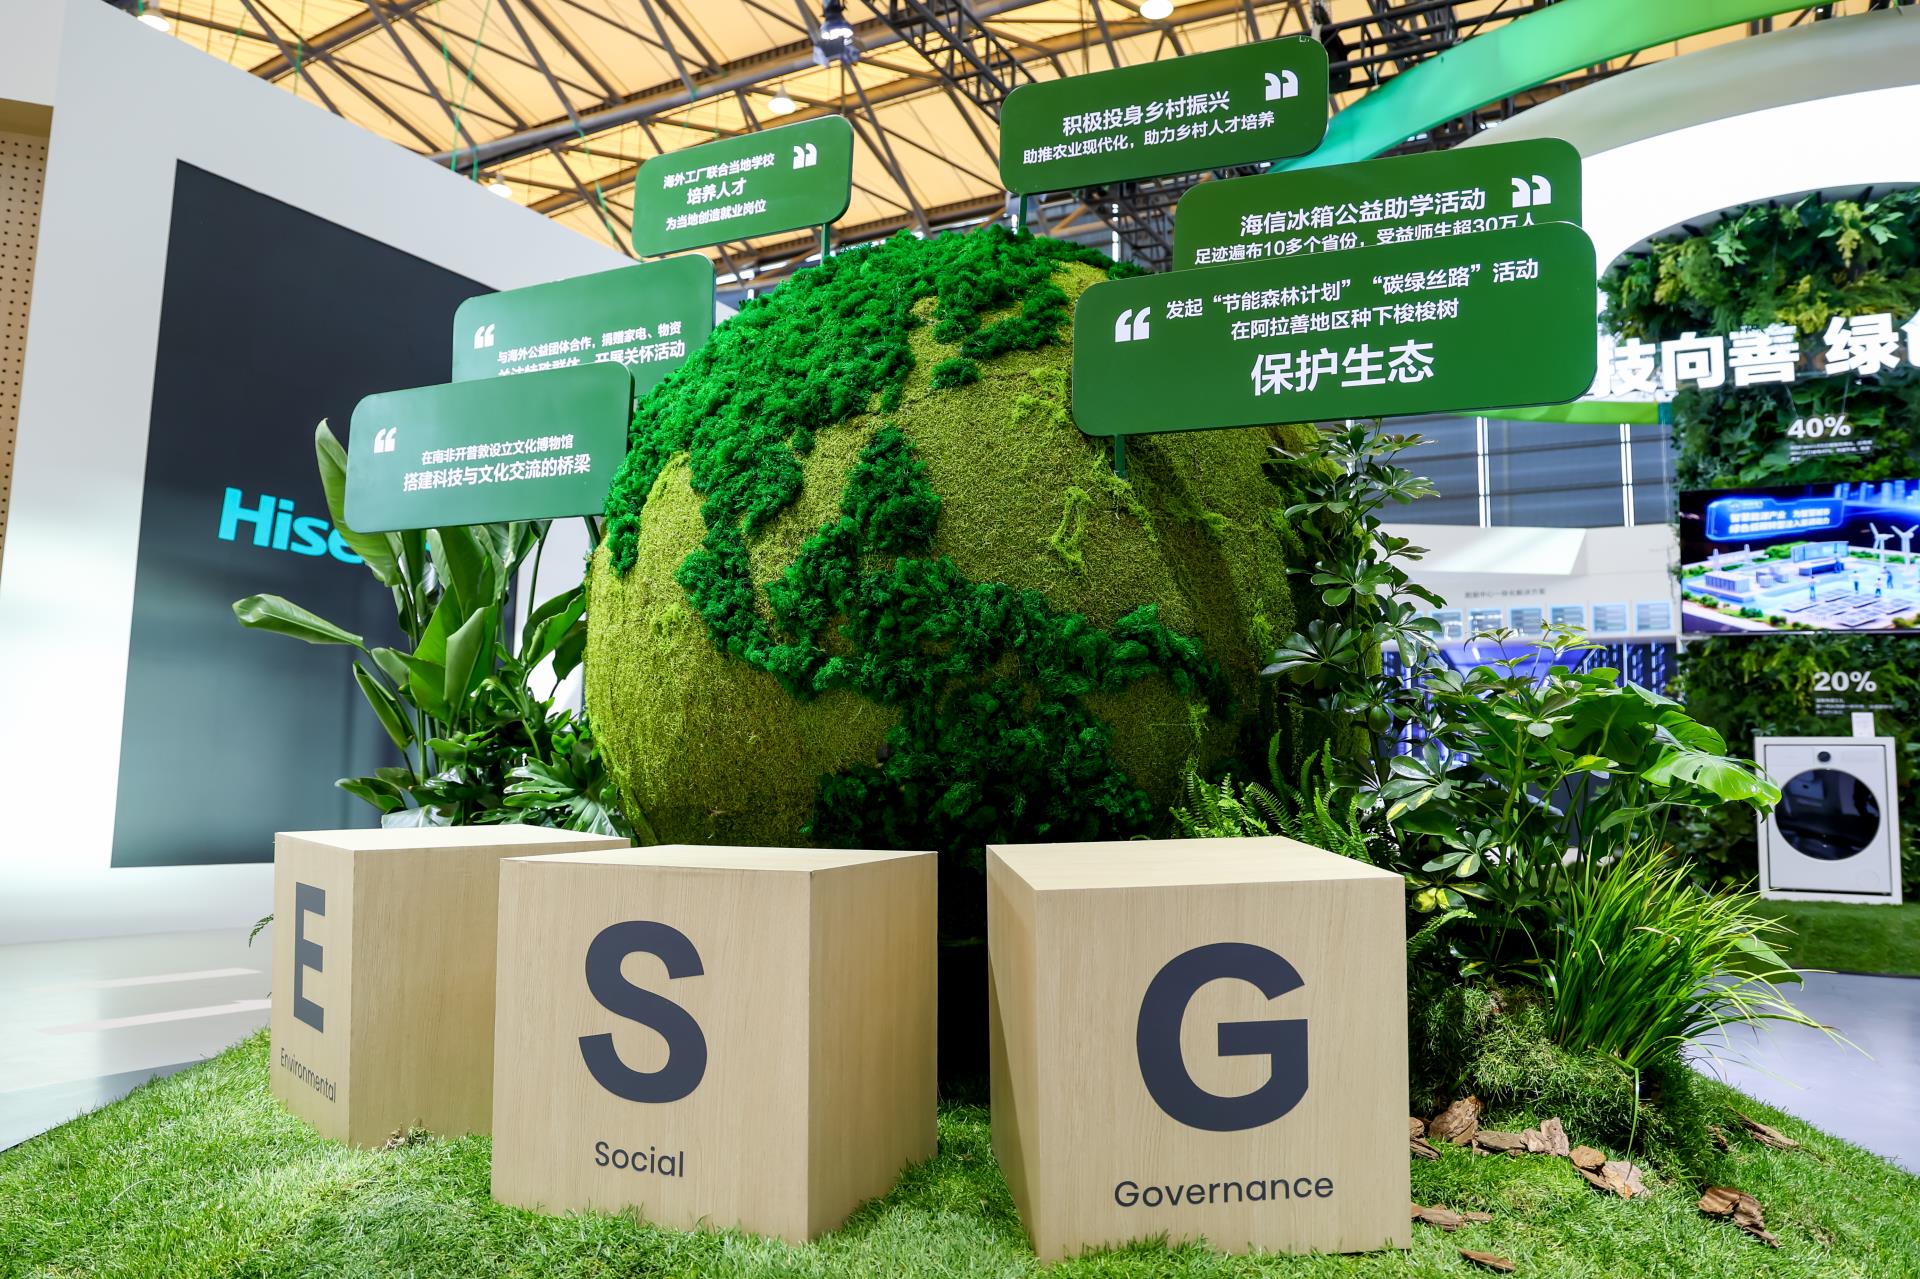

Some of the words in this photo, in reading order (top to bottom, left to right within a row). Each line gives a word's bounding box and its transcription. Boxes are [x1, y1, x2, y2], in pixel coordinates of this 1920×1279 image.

[1062, 90, 1230, 137] 积极投身乡村振兴
[1022, 110, 1275, 165] 助推农业现代化，助力乡村人才培养
[663, 152, 776, 189] 海外工厂联合当地学校
[686, 177, 747, 206] 培养人才
[1240, 187, 1486, 237] 海信冰箱公益助学活动
[665, 198, 767, 232] 为当地创造就业岗位
[1230, 297, 1460, 341] 在阿拉善地区种下梭梭树
[1250, 339, 1436, 396] 保护生态
[1787, 415, 1852, 438] 40%
[421, 433, 574, 466] 在南非开普敦设立文化博物馆
[403, 453, 591, 492] 搭建科技与文化交流的桥梁
[1813, 671, 1877, 692] 20%
[293, 881, 326, 1034] E
[578, 920, 708, 1104] S
[1136, 942, 1309, 1132] G
[280, 1047, 337, 1104] Environmental
[594, 1140, 684, 1178] Social
[1114, 1177, 1334, 1208] Governance
